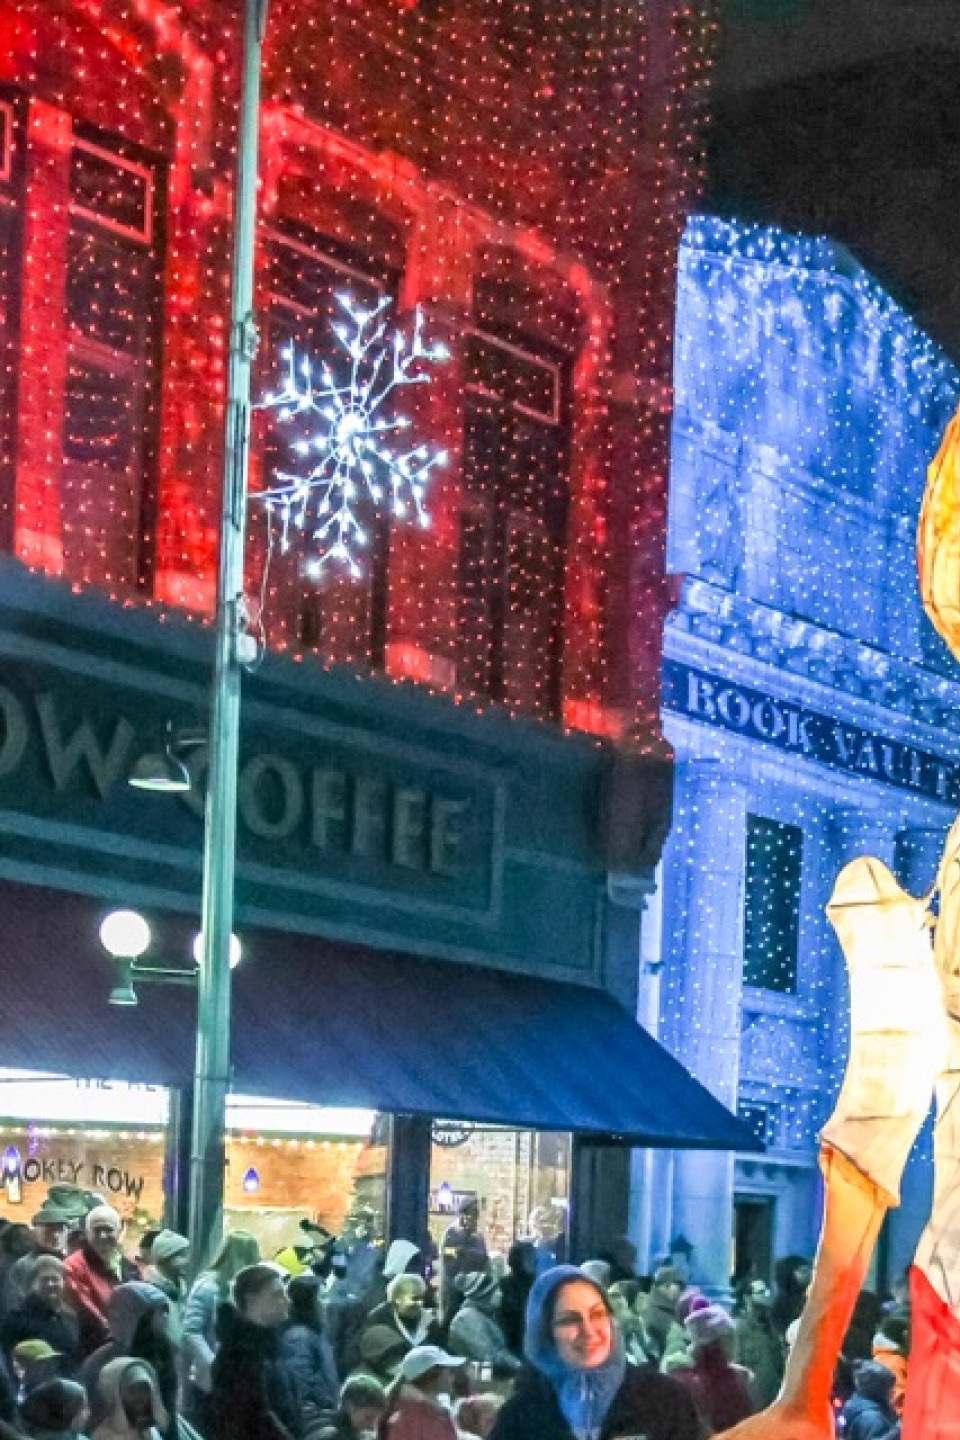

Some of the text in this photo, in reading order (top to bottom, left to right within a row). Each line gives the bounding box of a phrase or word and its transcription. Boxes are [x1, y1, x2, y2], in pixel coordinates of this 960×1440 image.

[687, 670, 815, 752] BOOK
[0, 1157, 145, 1200] MOKEY ROW
